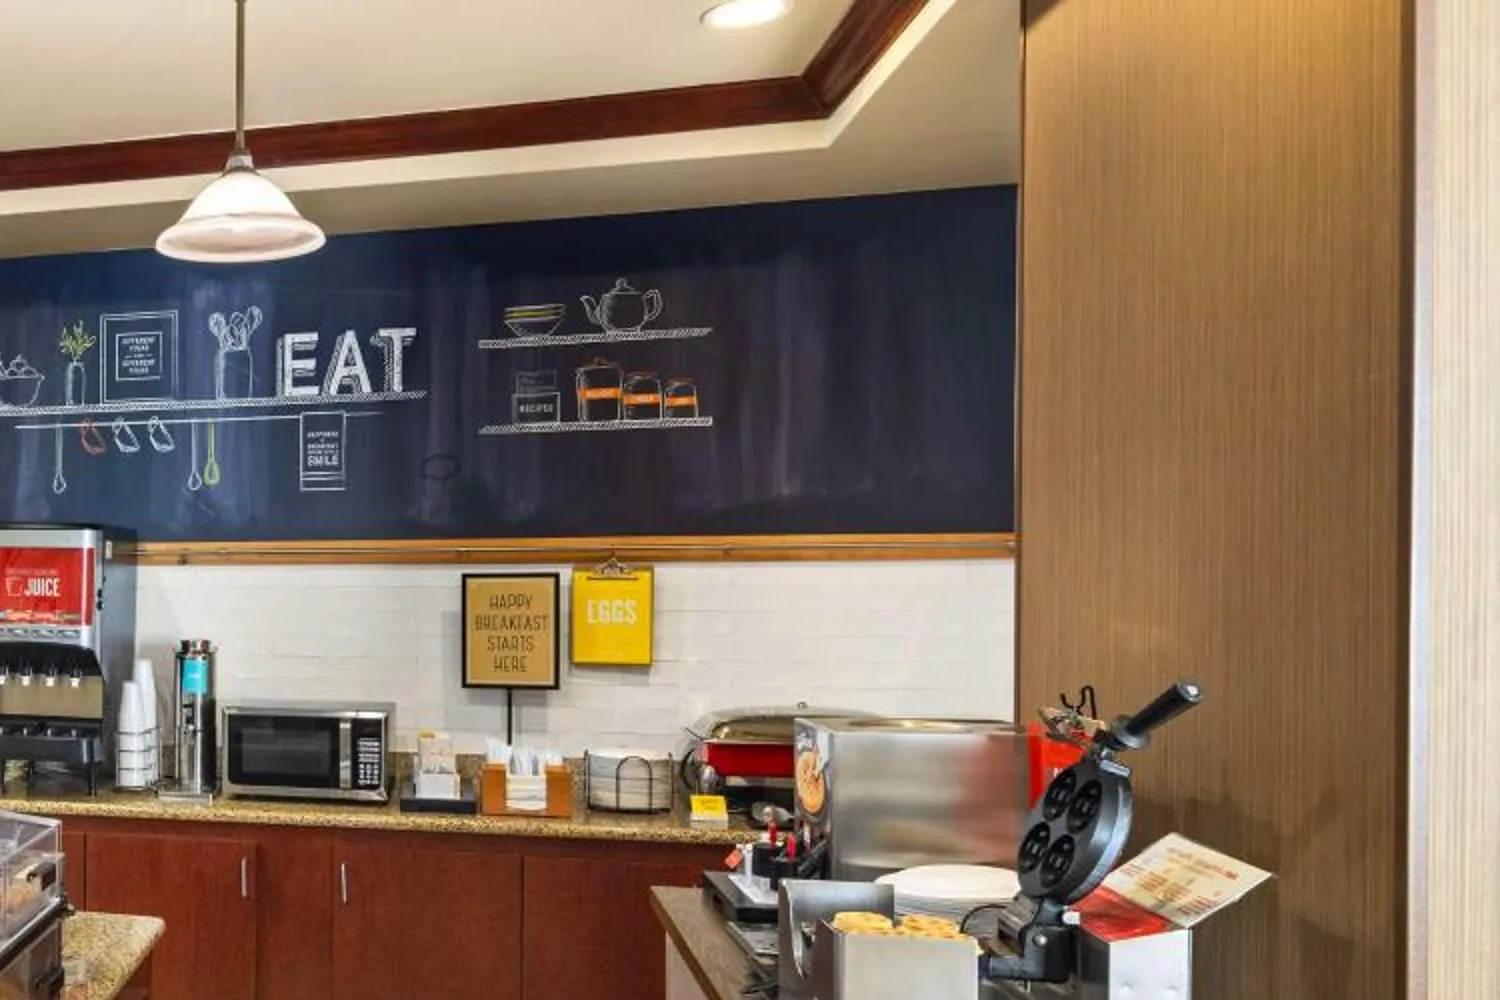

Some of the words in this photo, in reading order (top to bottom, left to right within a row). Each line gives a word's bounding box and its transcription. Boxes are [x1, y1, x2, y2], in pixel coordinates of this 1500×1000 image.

[277, 327, 417, 398] EAT
[24, 577, 60, 597] JUICE
[489, 593, 533, 611] HAPPY
[587, 598, 637, 624] EGGS
[475, 614, 548, 632] BREAKFAST
[487, 635, 535, 652] STARTS
[493, 655, 527, 673] HERE
